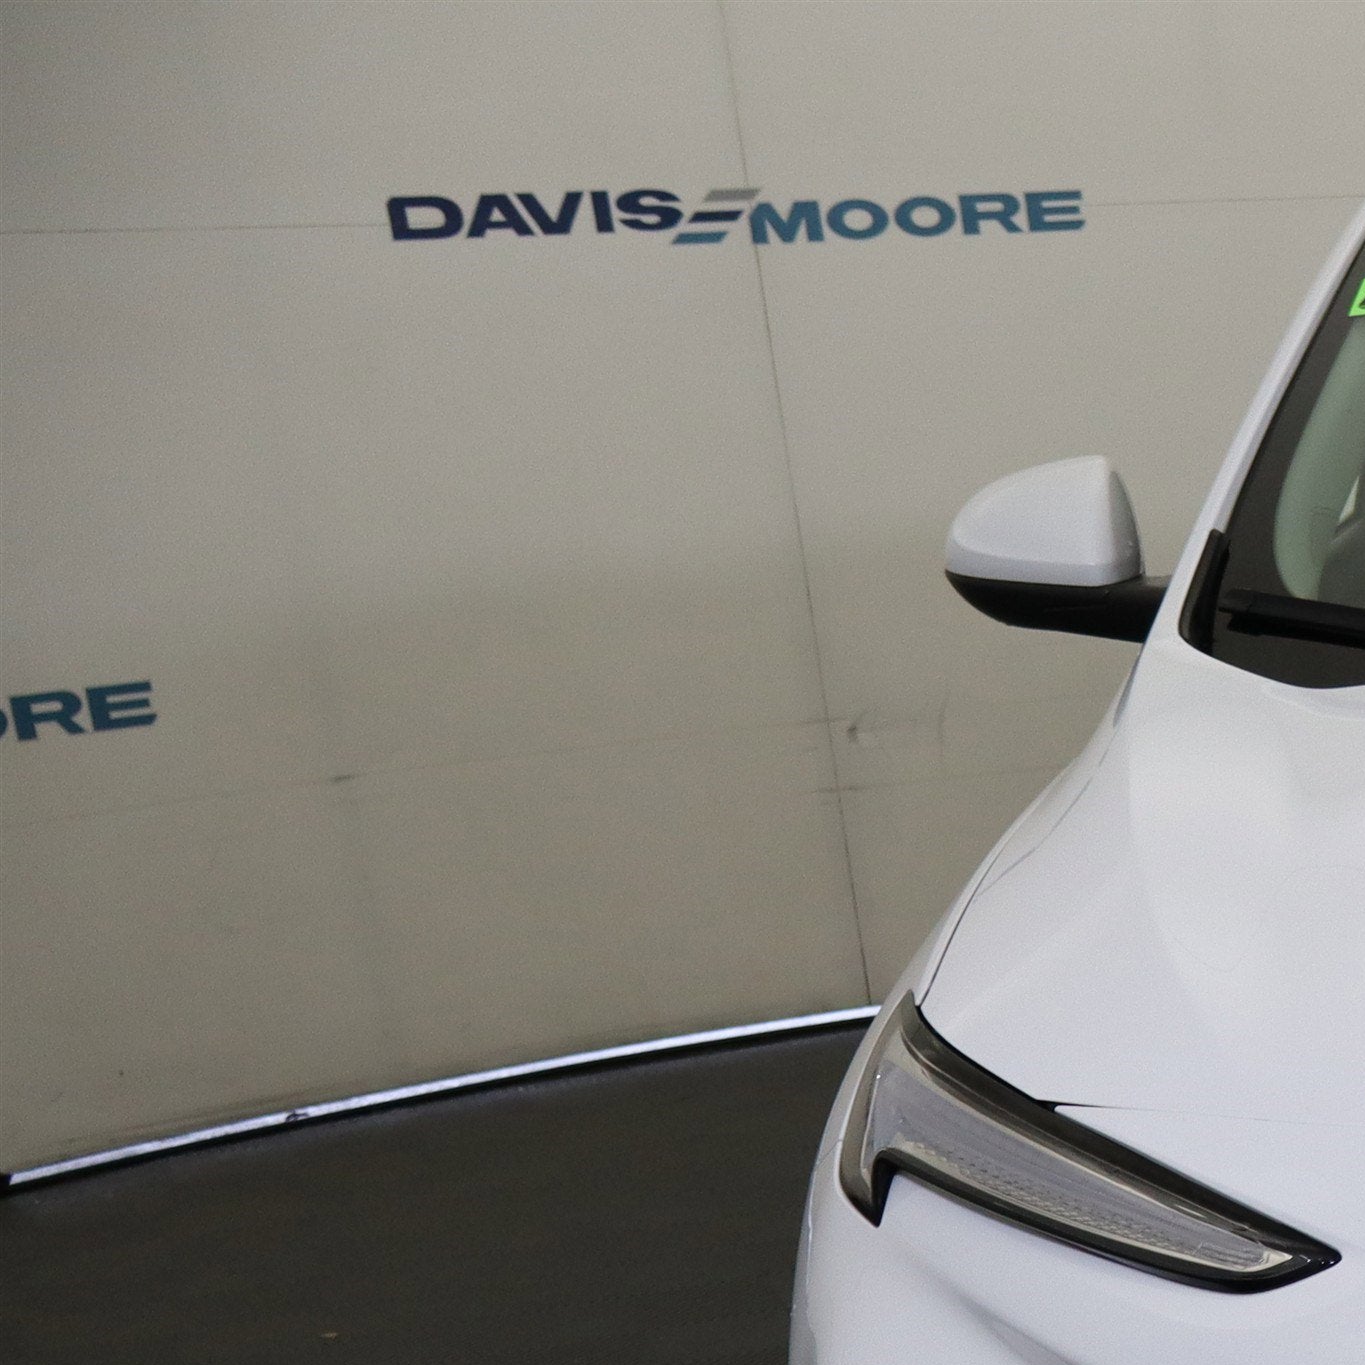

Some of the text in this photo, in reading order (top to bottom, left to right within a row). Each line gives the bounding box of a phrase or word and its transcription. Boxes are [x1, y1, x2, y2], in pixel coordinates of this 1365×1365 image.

[386, 189, 1087, 245] DAVIS MOORE
[0, 681, 158, 741] RE
